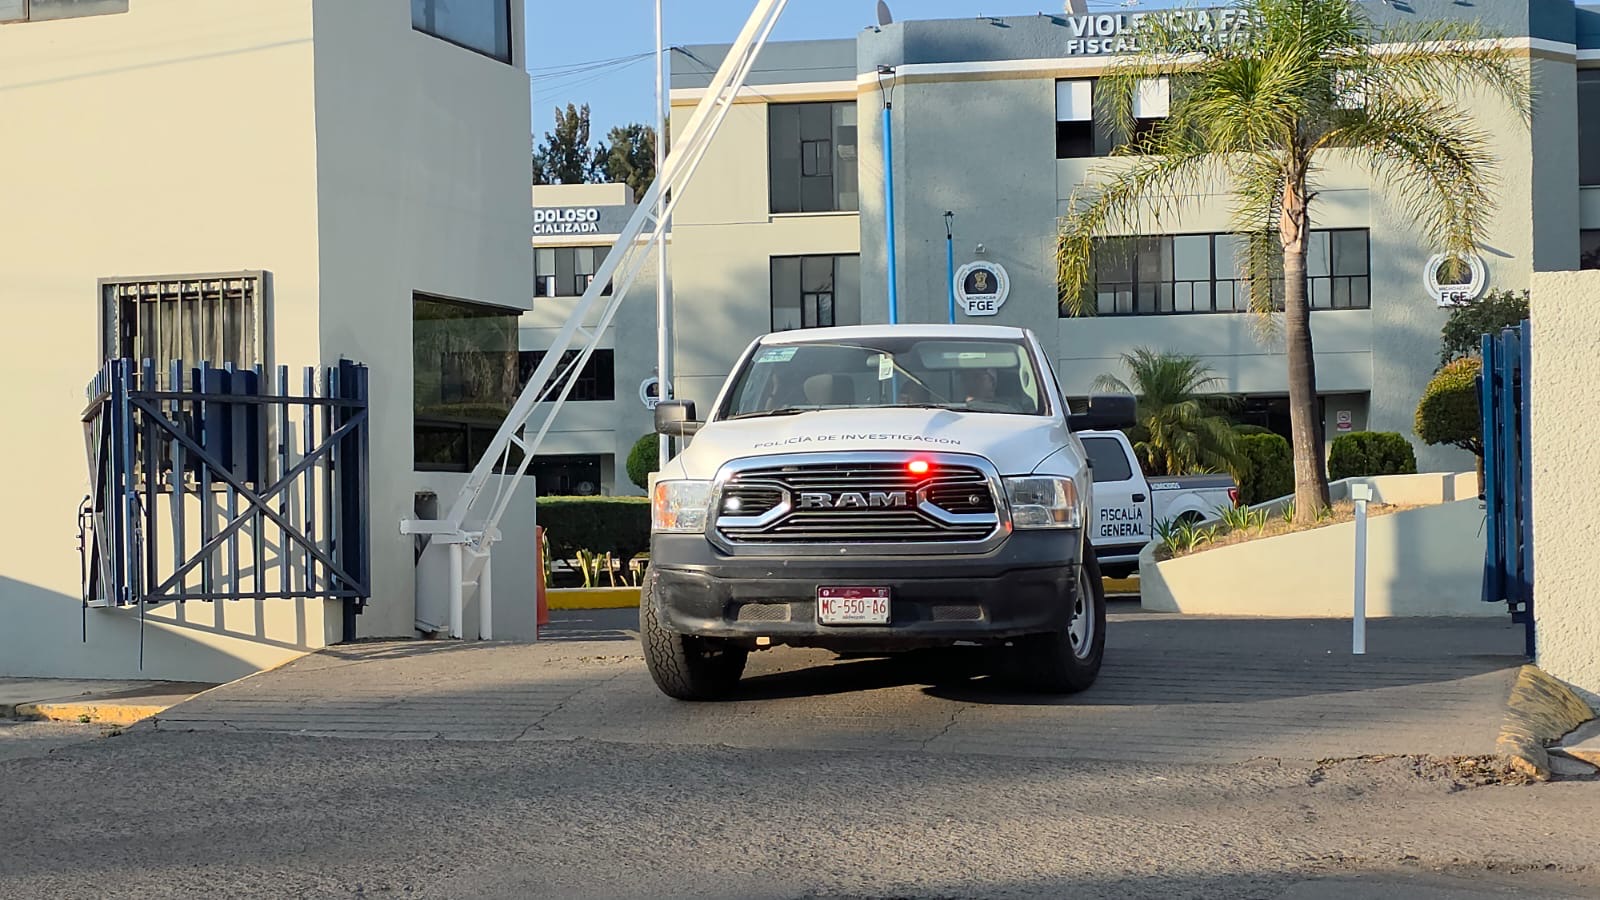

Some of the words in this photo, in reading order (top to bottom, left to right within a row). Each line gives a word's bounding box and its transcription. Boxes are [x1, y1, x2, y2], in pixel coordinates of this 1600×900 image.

[533, 208, 600, 223] DOLOSO
[533, 222, 600, 234] CIALIZADA
[1441, 291, 1471, 304] FGE
[968, 300, 994, 311] FGE
[800, 491, 907, 508] RAM
[1100, 504, 1143, 521] FISCALÍA
[1100, 522, 1145, 537] GENERAL
[822, 599, 887, 615] MC-550-A6
